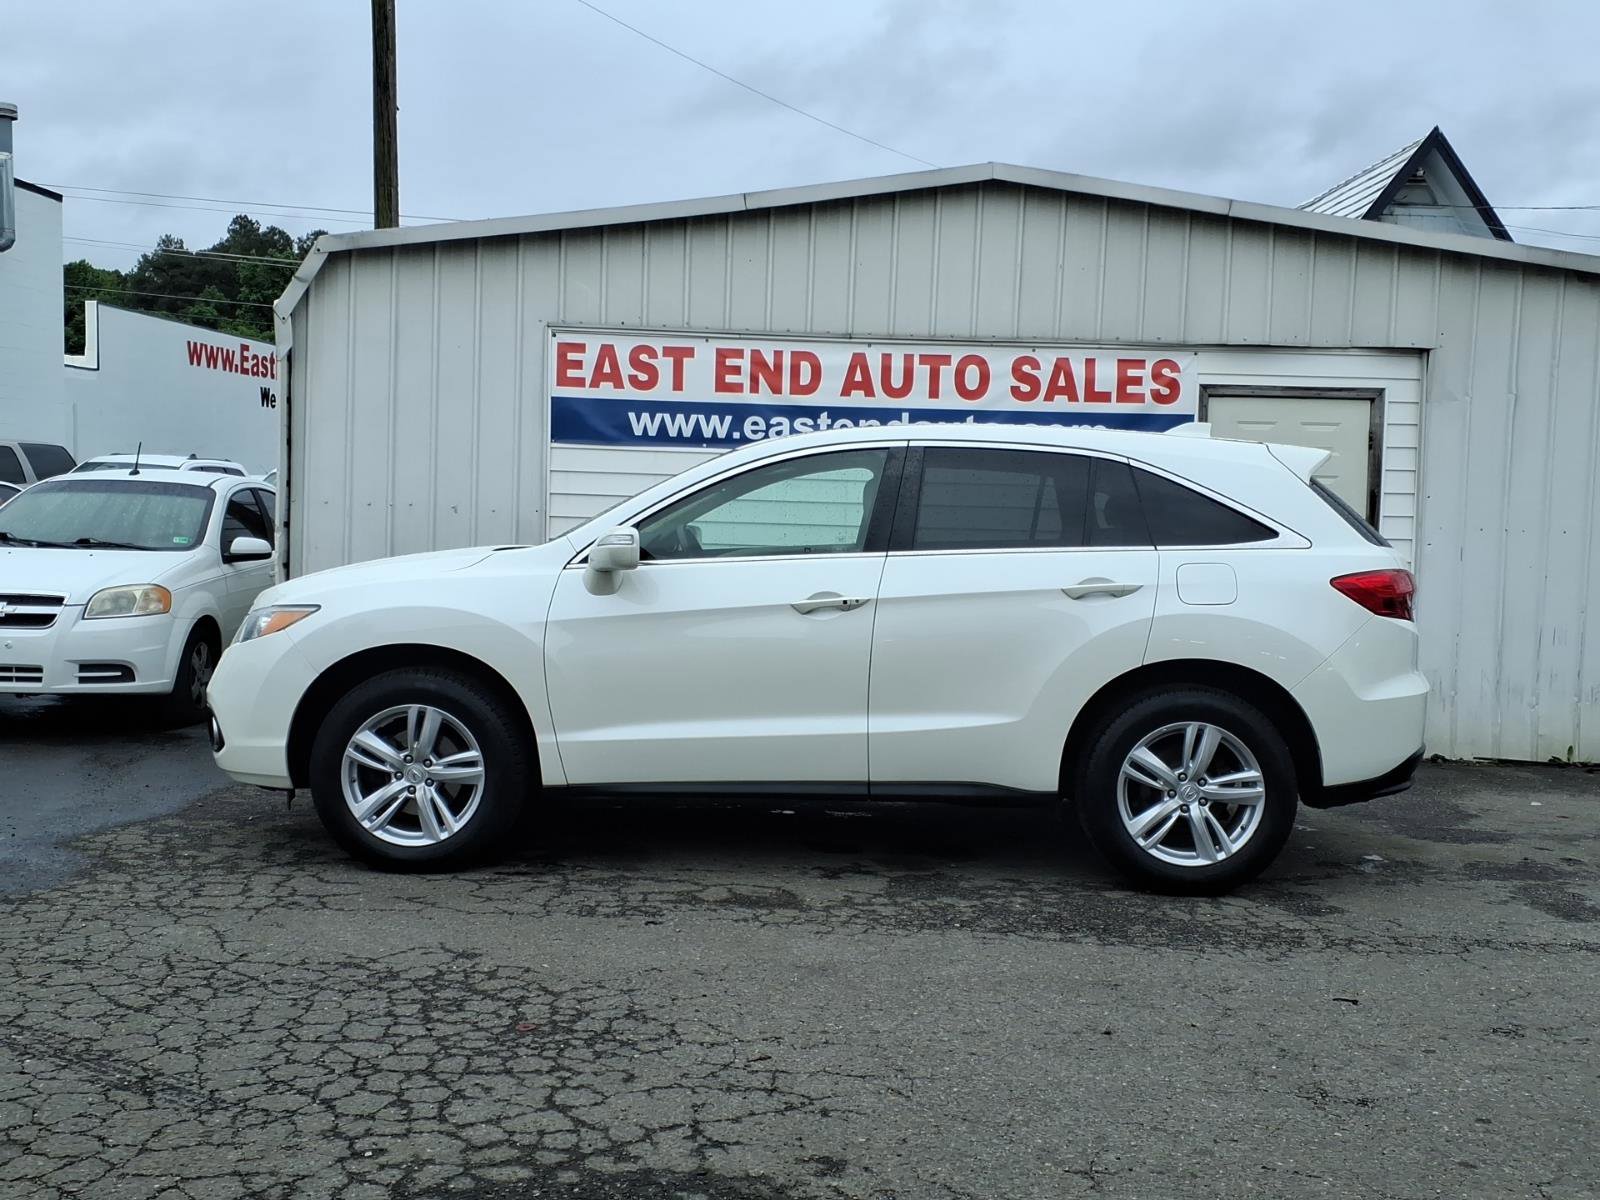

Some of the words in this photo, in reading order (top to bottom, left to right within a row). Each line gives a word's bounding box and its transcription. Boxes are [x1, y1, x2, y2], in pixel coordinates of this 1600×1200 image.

[187, 340, 277, 380] www.East
[555, 342, 696, 392] EAST
[715, 347, 822, 396] END
[839, 352, 992, 401] AUTO
[1010, 355, 1182, 405] SALES
[260, 386, 277, 409] We
